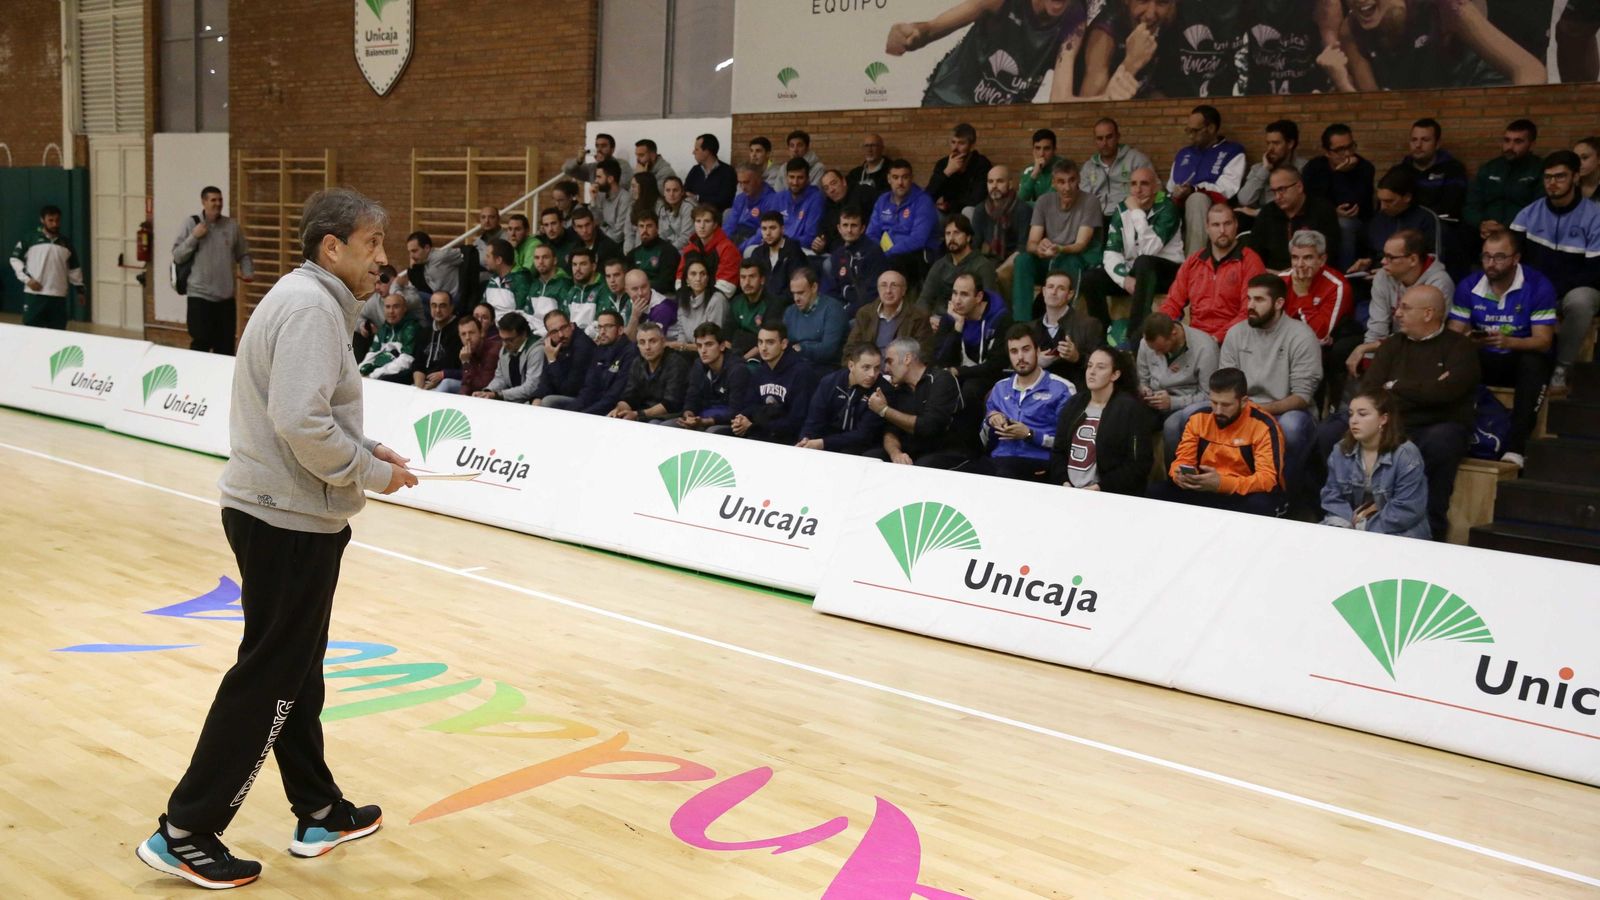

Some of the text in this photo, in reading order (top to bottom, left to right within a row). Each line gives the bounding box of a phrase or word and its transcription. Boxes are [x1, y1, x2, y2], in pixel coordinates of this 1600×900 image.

[812, 0, 887, 14] EQUIPO
[365, 26, 398, 43] Unicaja
[365, 48, 399, 57] Baloncesto
[71, 371, 114, 396] Unicaja
[163, 393, 209, 420] Unicaja
[456, 445, 530, 483] Unicaja
[719, 494, 819, 540] Unicaja
[964, 558, 1098, 617] Unicaja
[1475, 654, 1600, 716] Unic
